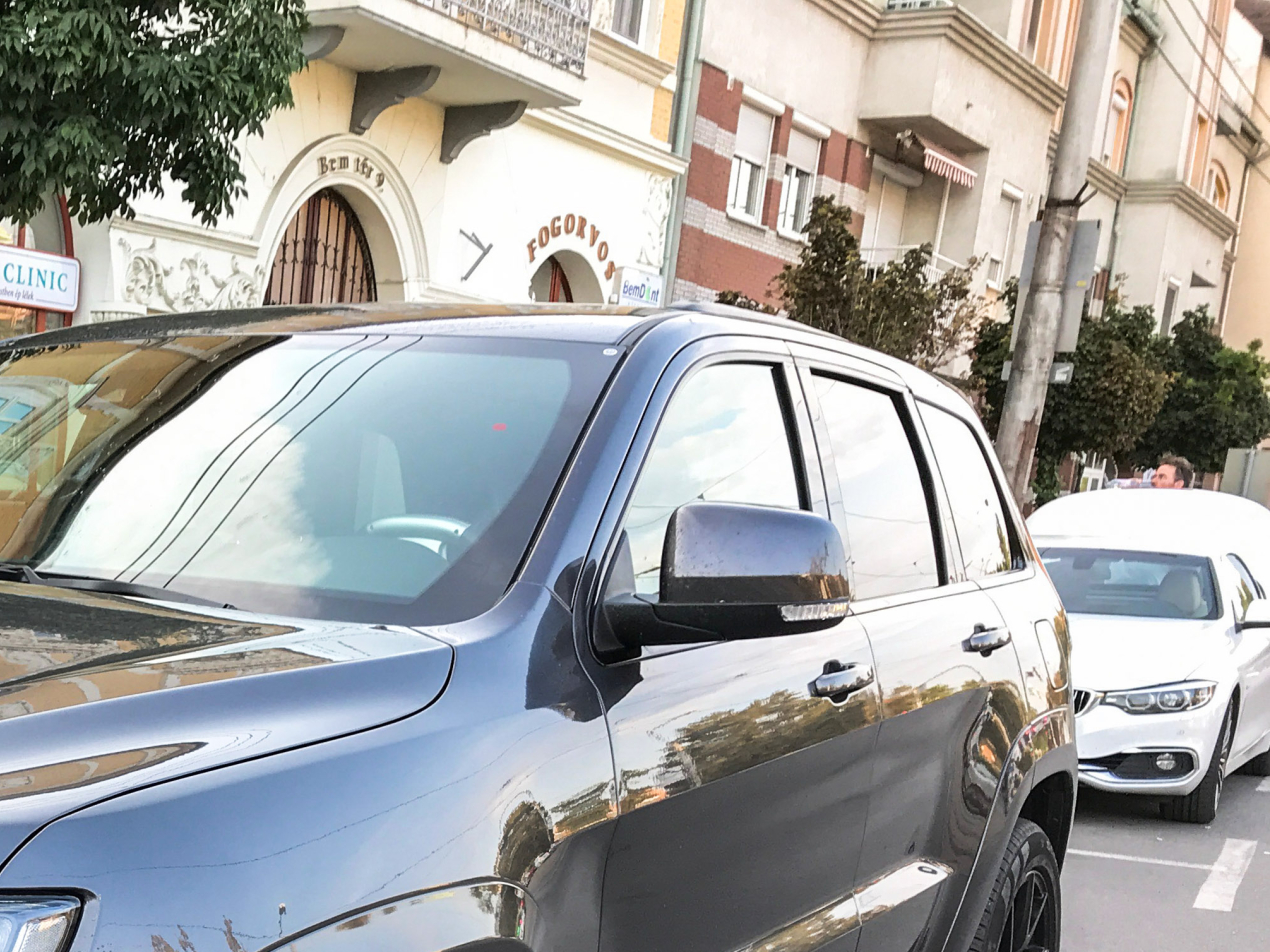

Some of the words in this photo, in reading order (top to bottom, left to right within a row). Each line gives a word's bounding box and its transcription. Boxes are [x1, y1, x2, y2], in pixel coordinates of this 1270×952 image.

[316, 156, 349, 176] Bem
[526, 213, 616, 281] FOGORVOS
[3, 262, 68, 292] CLINIC
